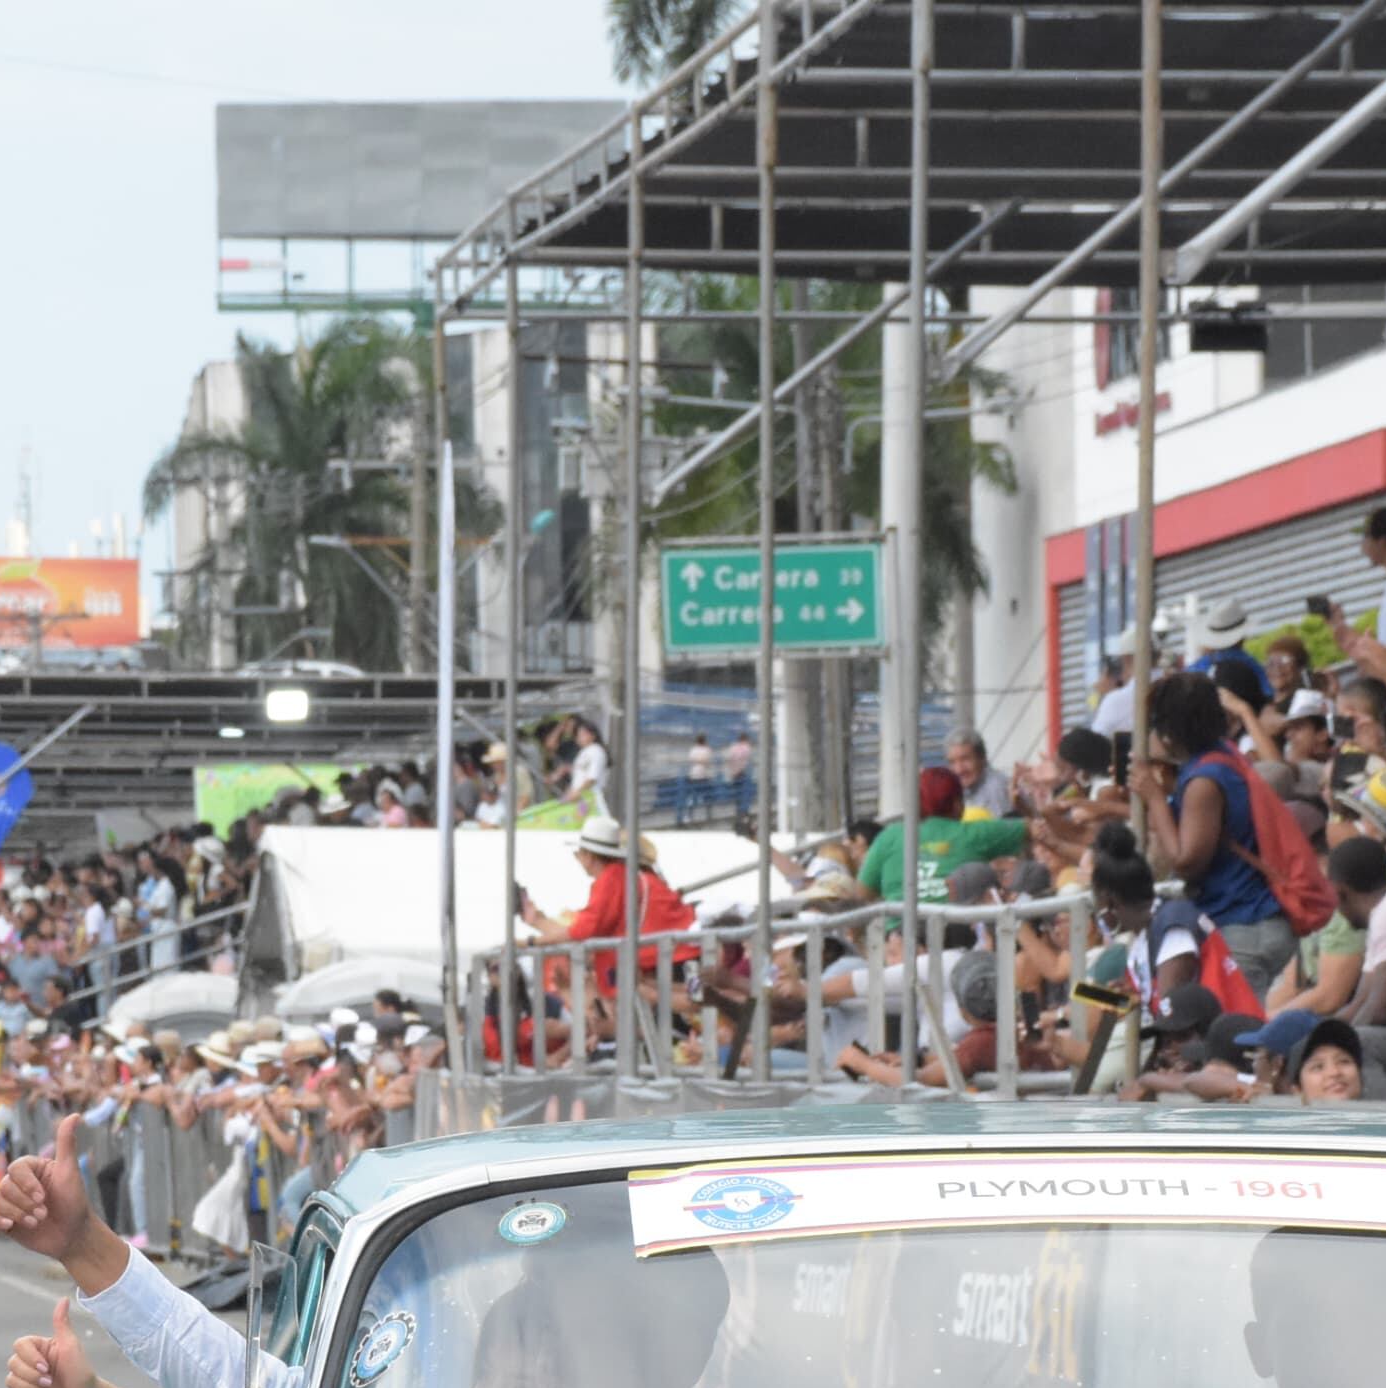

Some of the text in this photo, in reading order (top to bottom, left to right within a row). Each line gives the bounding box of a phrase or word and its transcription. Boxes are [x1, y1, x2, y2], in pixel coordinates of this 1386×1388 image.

[714, 565, 820, 591] Carera
[937, 1178, 1190, 1199] PLYMOUTH
[1230, 1179, 1324, 1200] 1961
[953, 1264, 1034, 1346] smart
